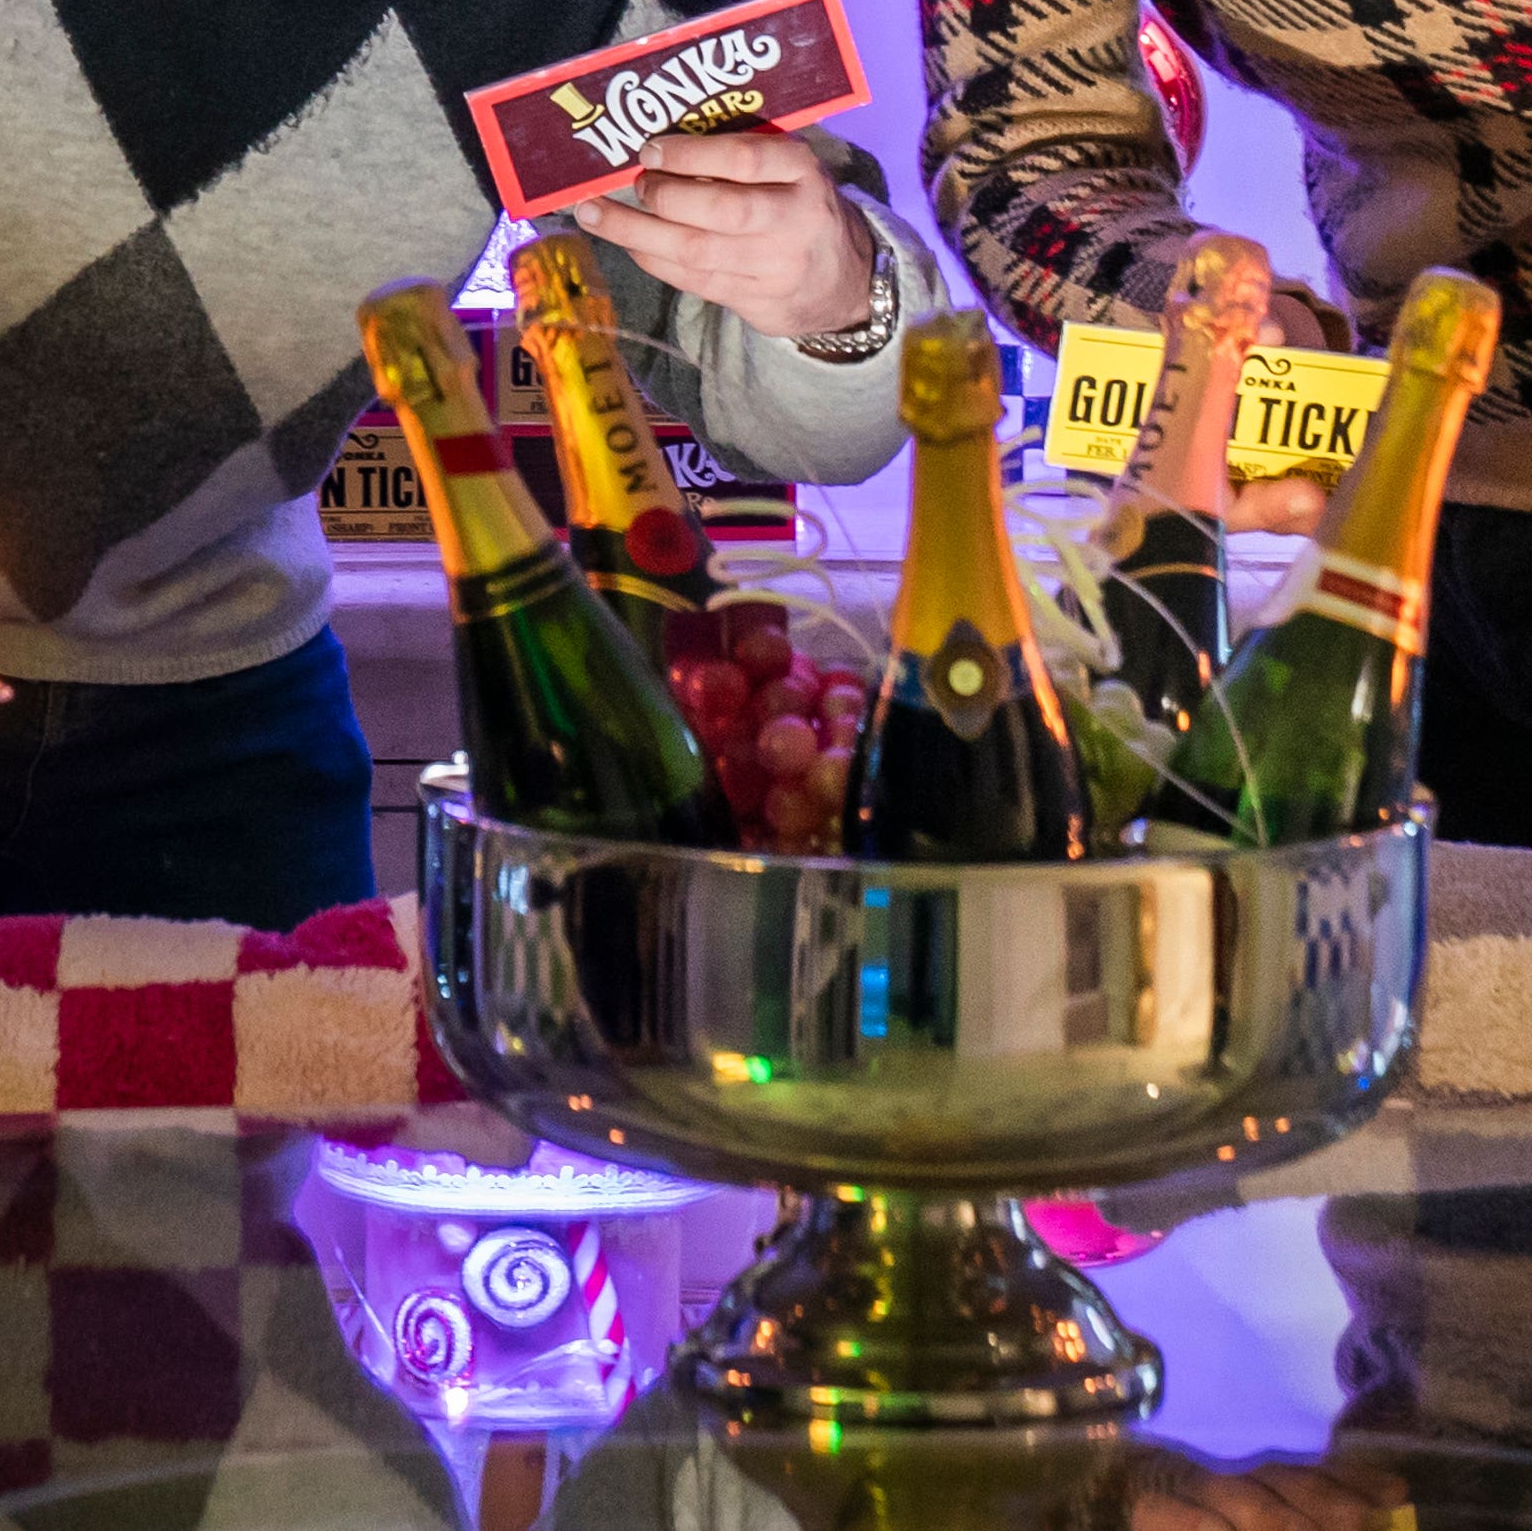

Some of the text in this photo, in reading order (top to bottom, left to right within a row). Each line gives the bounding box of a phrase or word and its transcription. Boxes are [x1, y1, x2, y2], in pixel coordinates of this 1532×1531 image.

[572, 29, 781, 167] WONKA
[678, 90, 764, 134] BAR
[1242, 353, 1297, 392] ONKA
[1260, 397, 1360, 456] TICK
